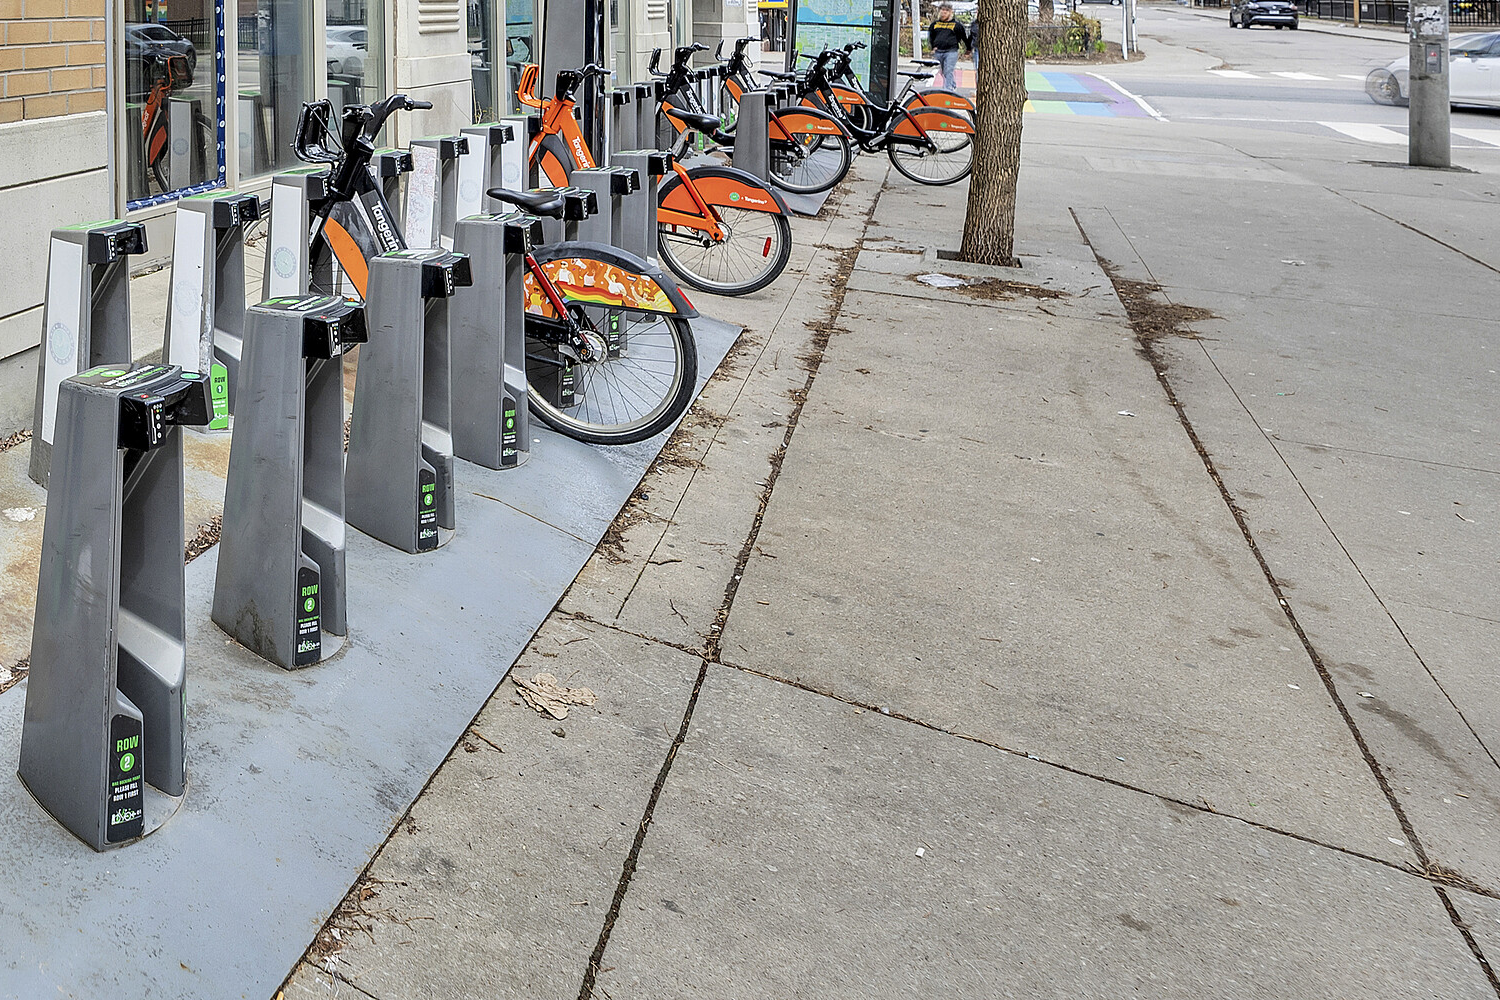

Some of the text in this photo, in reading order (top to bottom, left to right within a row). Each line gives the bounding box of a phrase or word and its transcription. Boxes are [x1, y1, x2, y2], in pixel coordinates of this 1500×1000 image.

[372, 200, 399, 251] Tangerin
[427, 496, 430, 504] 2
[302, 584, 318, 596] ROW
[308, 600, 312, 610] 2
[116, 735, 139, 752] ROW
[124, 756, 130, 768] 2
[115, 784, 129, 793] PLEASE
[128, 789, 139, 798] FIRST
